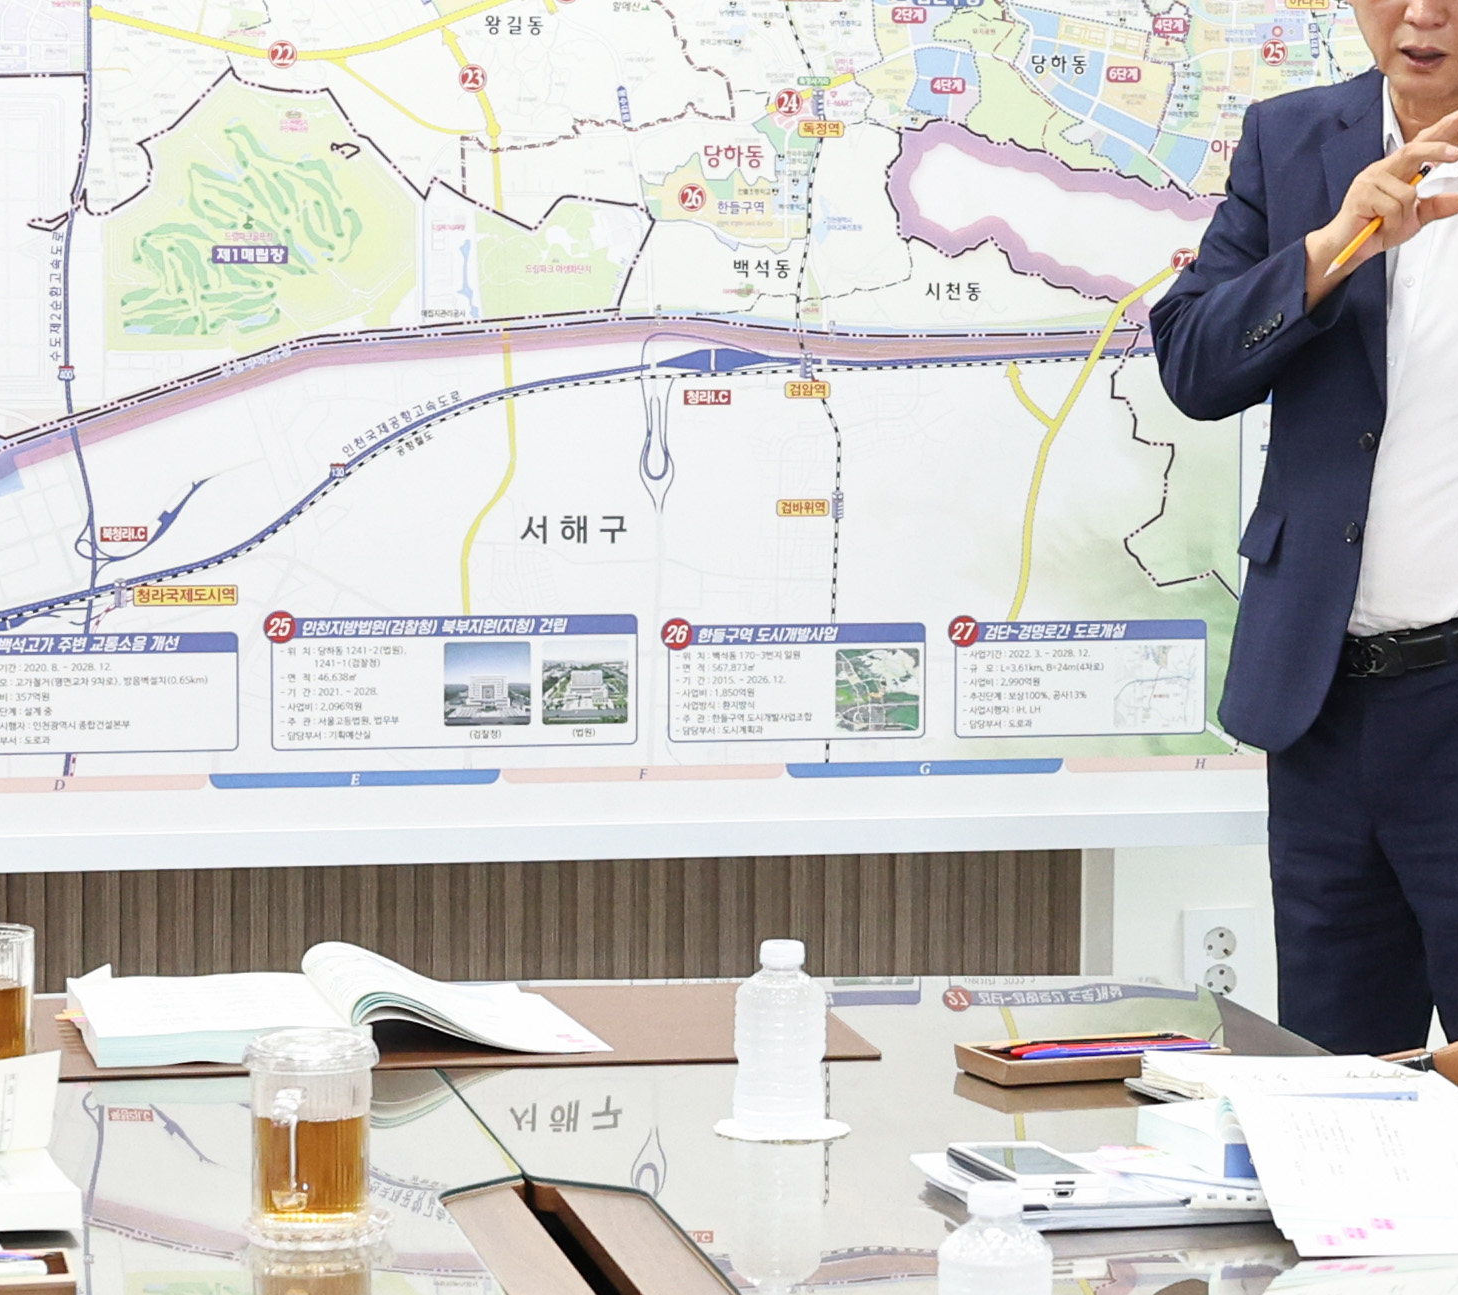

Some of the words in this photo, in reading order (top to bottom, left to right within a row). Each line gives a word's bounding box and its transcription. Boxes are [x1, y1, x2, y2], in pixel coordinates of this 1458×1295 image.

[485, 15, 544, 36] 왕길동
[1031, 55, 1087, 75] 당하동
[803, 122, 840, 135] 독정역
[704, 145, 764, 168] 당하동
[717, 200, 764, 215] 한들구역
[216, 247, 285, 263] 제1매립장
[733, 259, 791, 279] 백석동
[925, 282, 981, 301] 시천동
[790, 384, 826, 397] 검암역
[781, 501, 825, 514] 검바위역
[520, 515, 627, 544] 서해구
[136, 587, 236, 603] 청라국제도시역
[267, 618, 291, 637] 25
[302, 619, 437, 636] 인천지방법원(검찰청)
[441, 618, 534, 634] 북부지원(지청)
[538, 617, 568, 634] 건립
[665, 624, 689, 644] 26
[698, 627, 753, 643] 한들구역
[755, 626, 838, 643] 도시개발사업
[952, 622, 975, 641] 27
[984, 624, 1071, 641] 검단~경명로간
[1074, 623, 1127, 639] 도로개설
[58, 637, 87, 652] 주변
[89, 636, 147, 653] 교통소음
[150, 635, 180, 651] 개선
